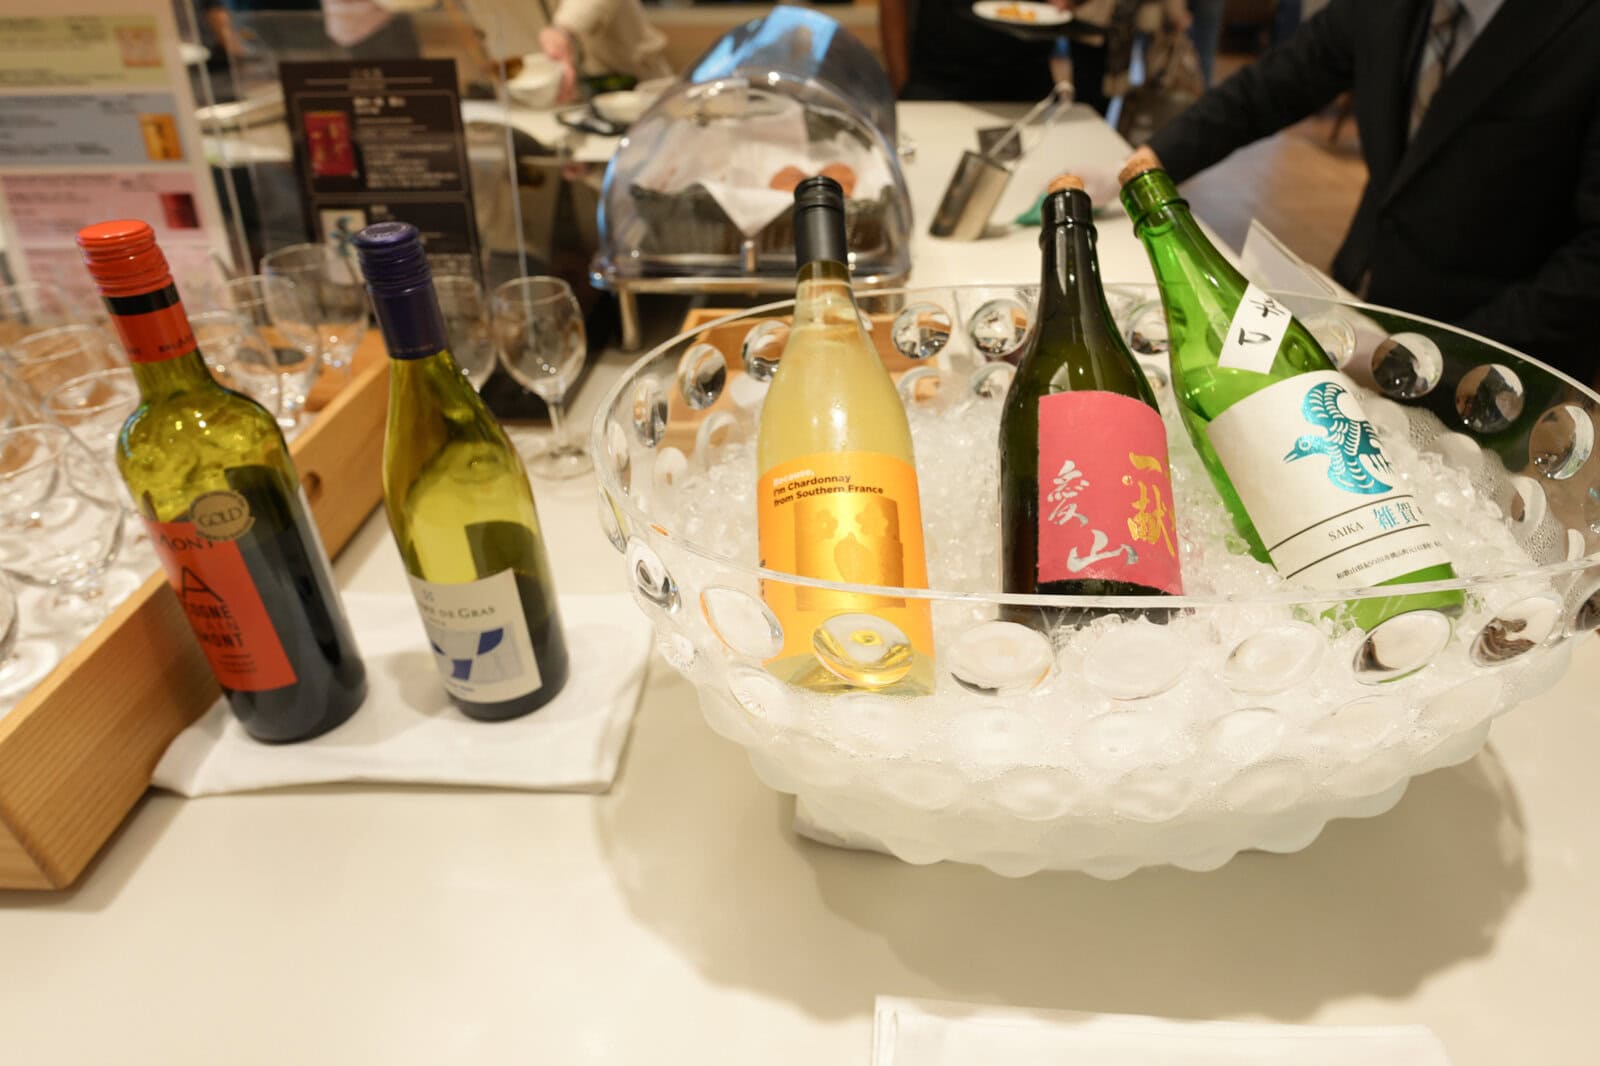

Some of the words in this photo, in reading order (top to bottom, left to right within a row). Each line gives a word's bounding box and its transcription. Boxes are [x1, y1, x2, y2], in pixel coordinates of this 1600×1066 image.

[774, 494, 794, 508] from
[796, 486, 845, 500] Southern
[848, 485, 884, 494] France
[788, 475, 851, 491] Chardonnay
[198, 507, 243, 527] GOLD
[1047, 459, 1139, 573] 愛山
[1328, 522, 1364, 541] SAIKA
[1373, 502, 1419, 531] 雑賀
[181, 566, 225, 602] A
